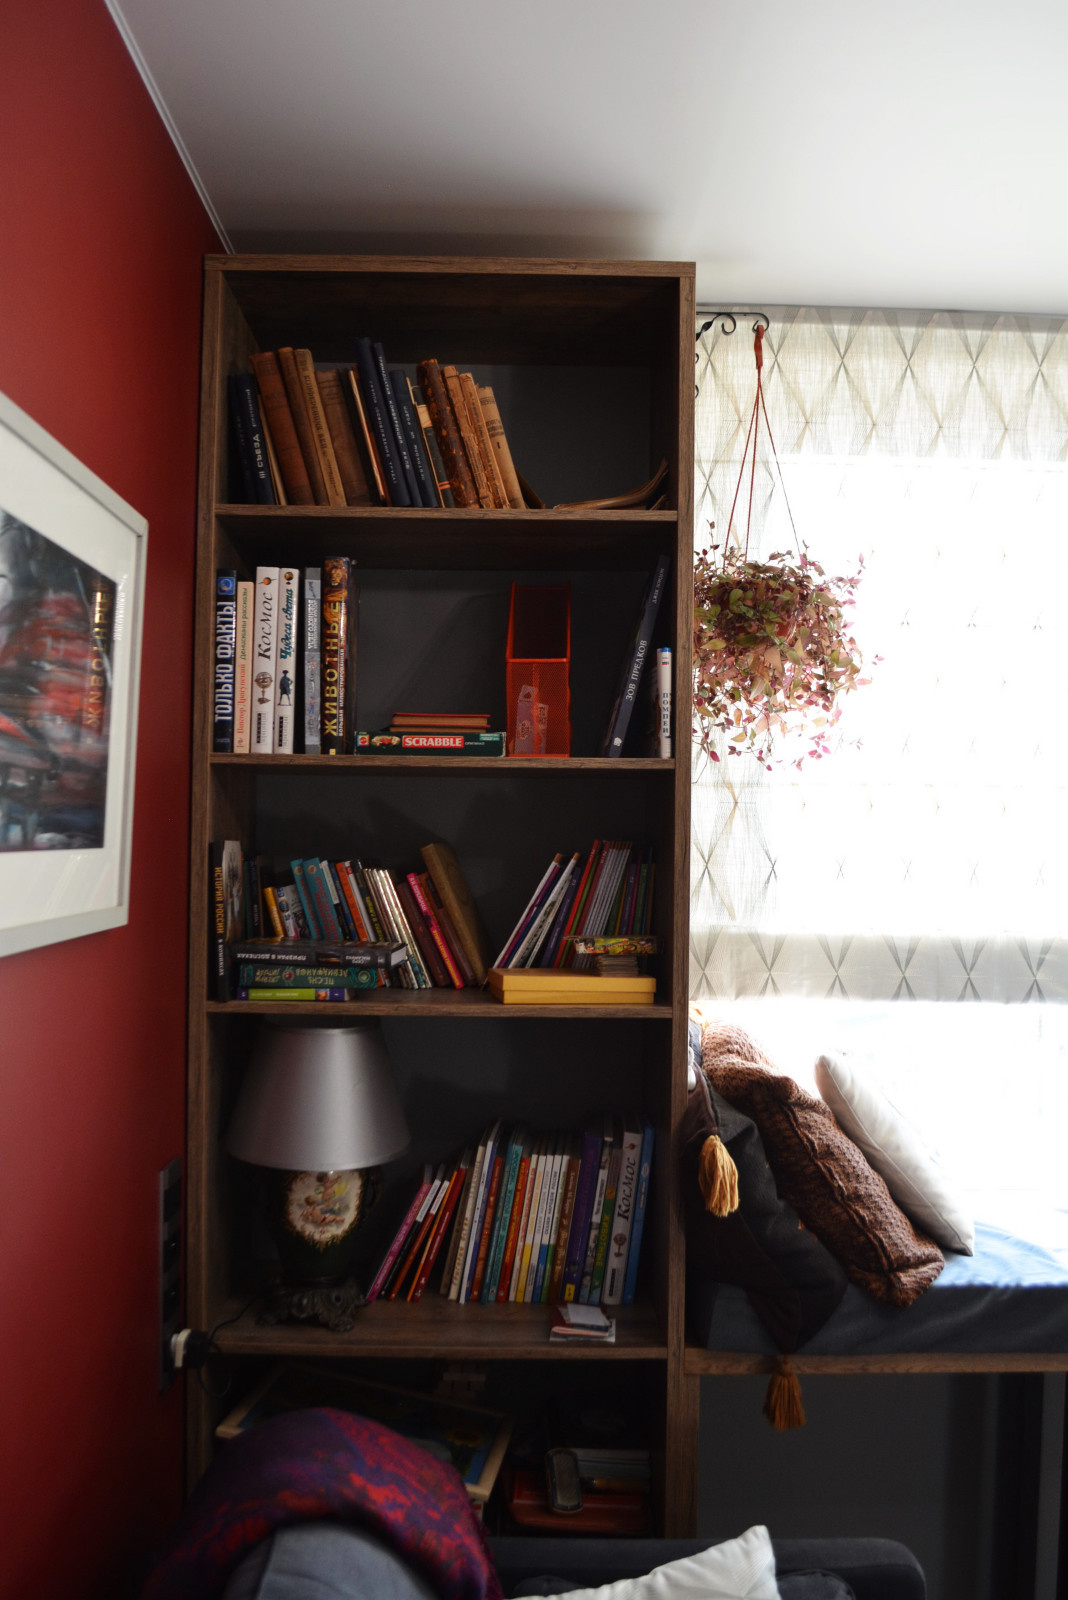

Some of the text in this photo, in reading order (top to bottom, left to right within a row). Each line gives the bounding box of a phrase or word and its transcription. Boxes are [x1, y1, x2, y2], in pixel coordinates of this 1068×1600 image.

[377, 355, 391, 395] ТРИНАДЦАТАЯ
[387, 399, 403, 444] КОНФЕРЕНЦИЯ
[251, 433, 265, 468] СЪЕЗД
[258, 592, 273, 661] Космос
[280, 588, 294, 660] Чудеса света
[215, 602, 236, 723] ТОЛЬКО ФАКТЫ
[324, 602, 339, 736] ЖИВОТНЫЕ
[626, 680, 637, 701] ЗОВ
[632, 640, 648, 680] ПРЕДКОВ
[662, 692, 670, 734] ПОМПЕИ
[404, 737, 463, 747] SCRABBLE
[214, 866, 222, 901] ИСТОРИЯ
[216, 902, 224, 934] РОССИИ
[295, 968, 349, 978] ЛЕВИАФАНОВ
[307, 976, 334, 985] ПЕСНЬ
[617, 1157, 636, 1221] Космос
[596, 1214, 610, 1266] ЖИВОТНЫЕ
